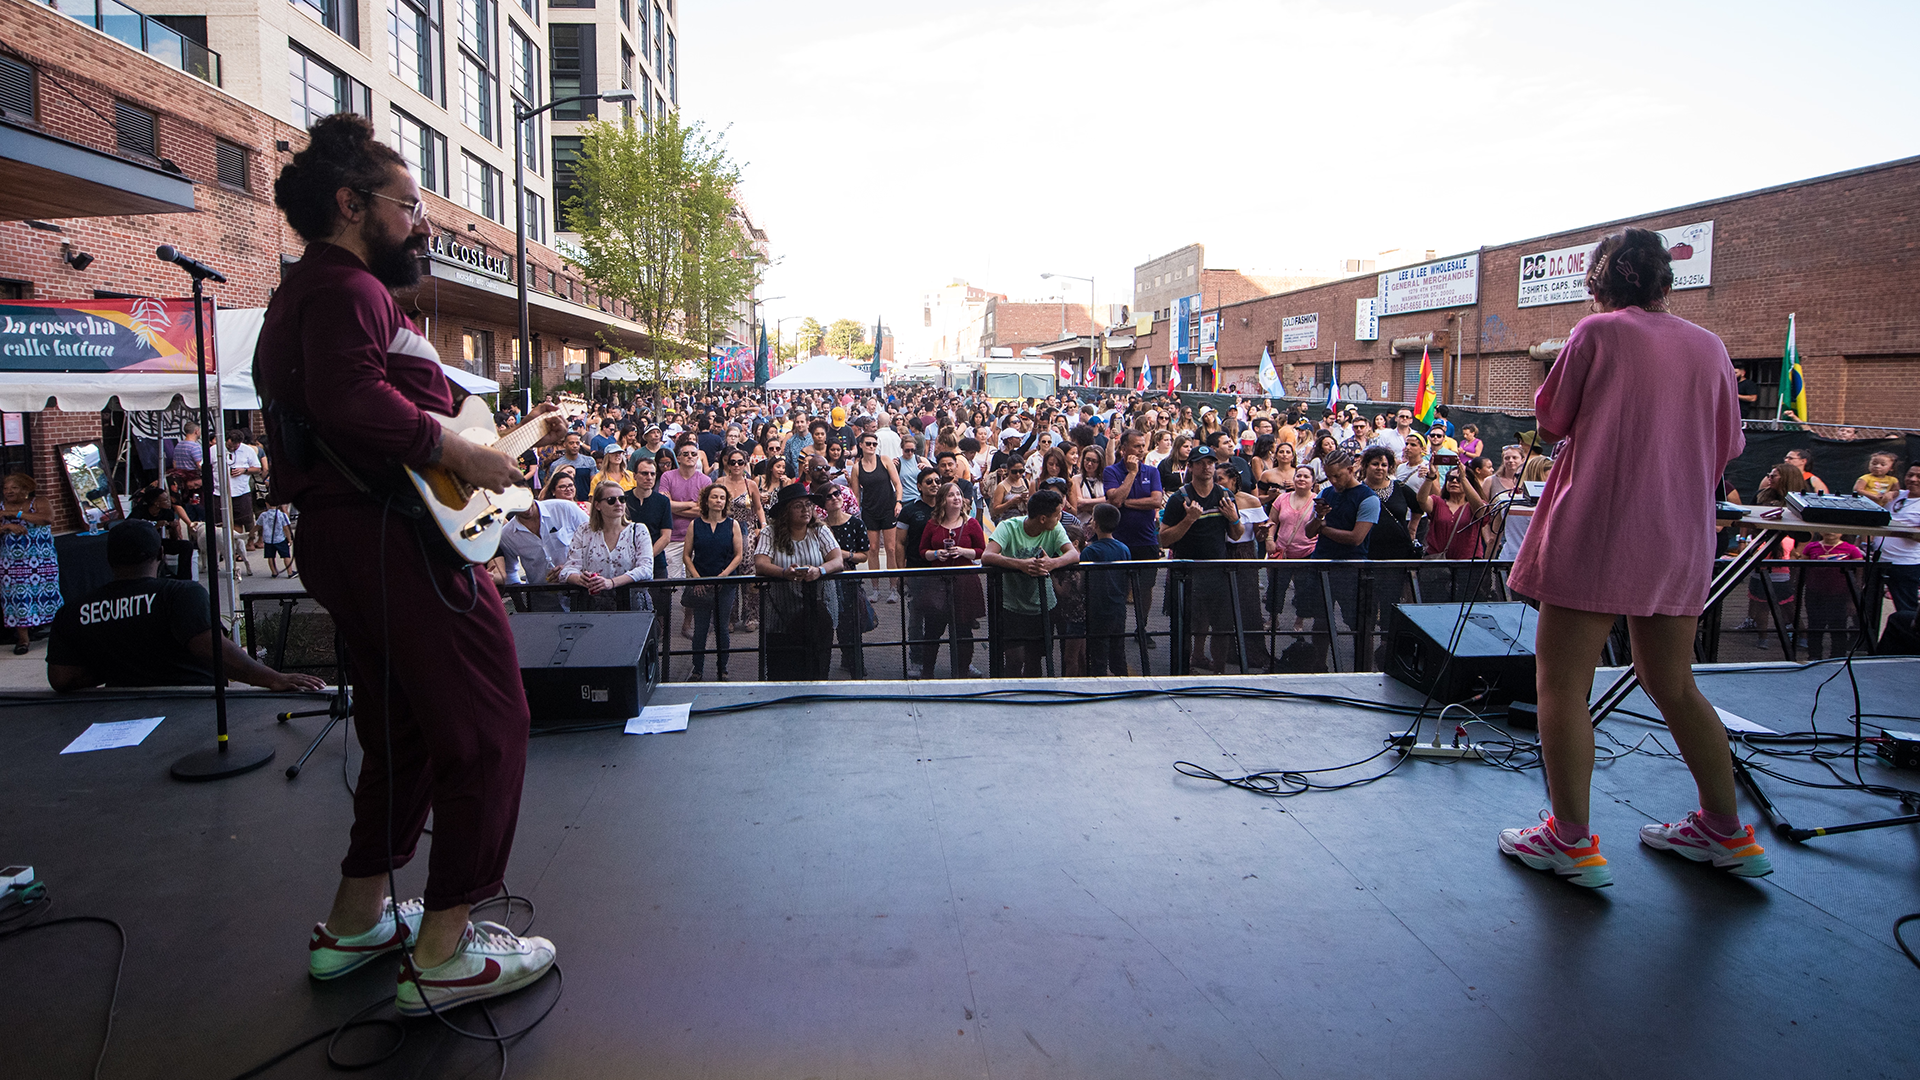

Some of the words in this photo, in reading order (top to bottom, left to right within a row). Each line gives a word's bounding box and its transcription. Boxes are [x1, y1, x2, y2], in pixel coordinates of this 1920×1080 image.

[428, 236, 444, 255] LA
[451, 241, 508, 277] COSECHA
[1549, 255, 1565, 277] D.C.
[1567, 252, 1585, 274] ONE
[1399, 270, 1409, 280] LEE
[1416, 267, 1427, 278] LEE
[1431, 258, 1467, 275] WHOLESALE
[1523, 254, 1546, 281] DC
[1391, 280, 1420, 291] GENERAL
[1422, 269, 1475, 285] MERCHANDISE
[1430, 283, 1448, 292] STREET
[1401, 293, 1430, 302] WASHINGTON
[3, 316, 27, 335] la
[29, 316, 116, 336] cosecha
[1283, 318, 1294, 327] GOLD
[1295, 313, 1317, 325] FASHION
[3, 338, 51, 358] calle
[53, 339, 115, 358] latina
[80, 592, 157, 626] SECURITY
[582, 686, 589, 698] 9
